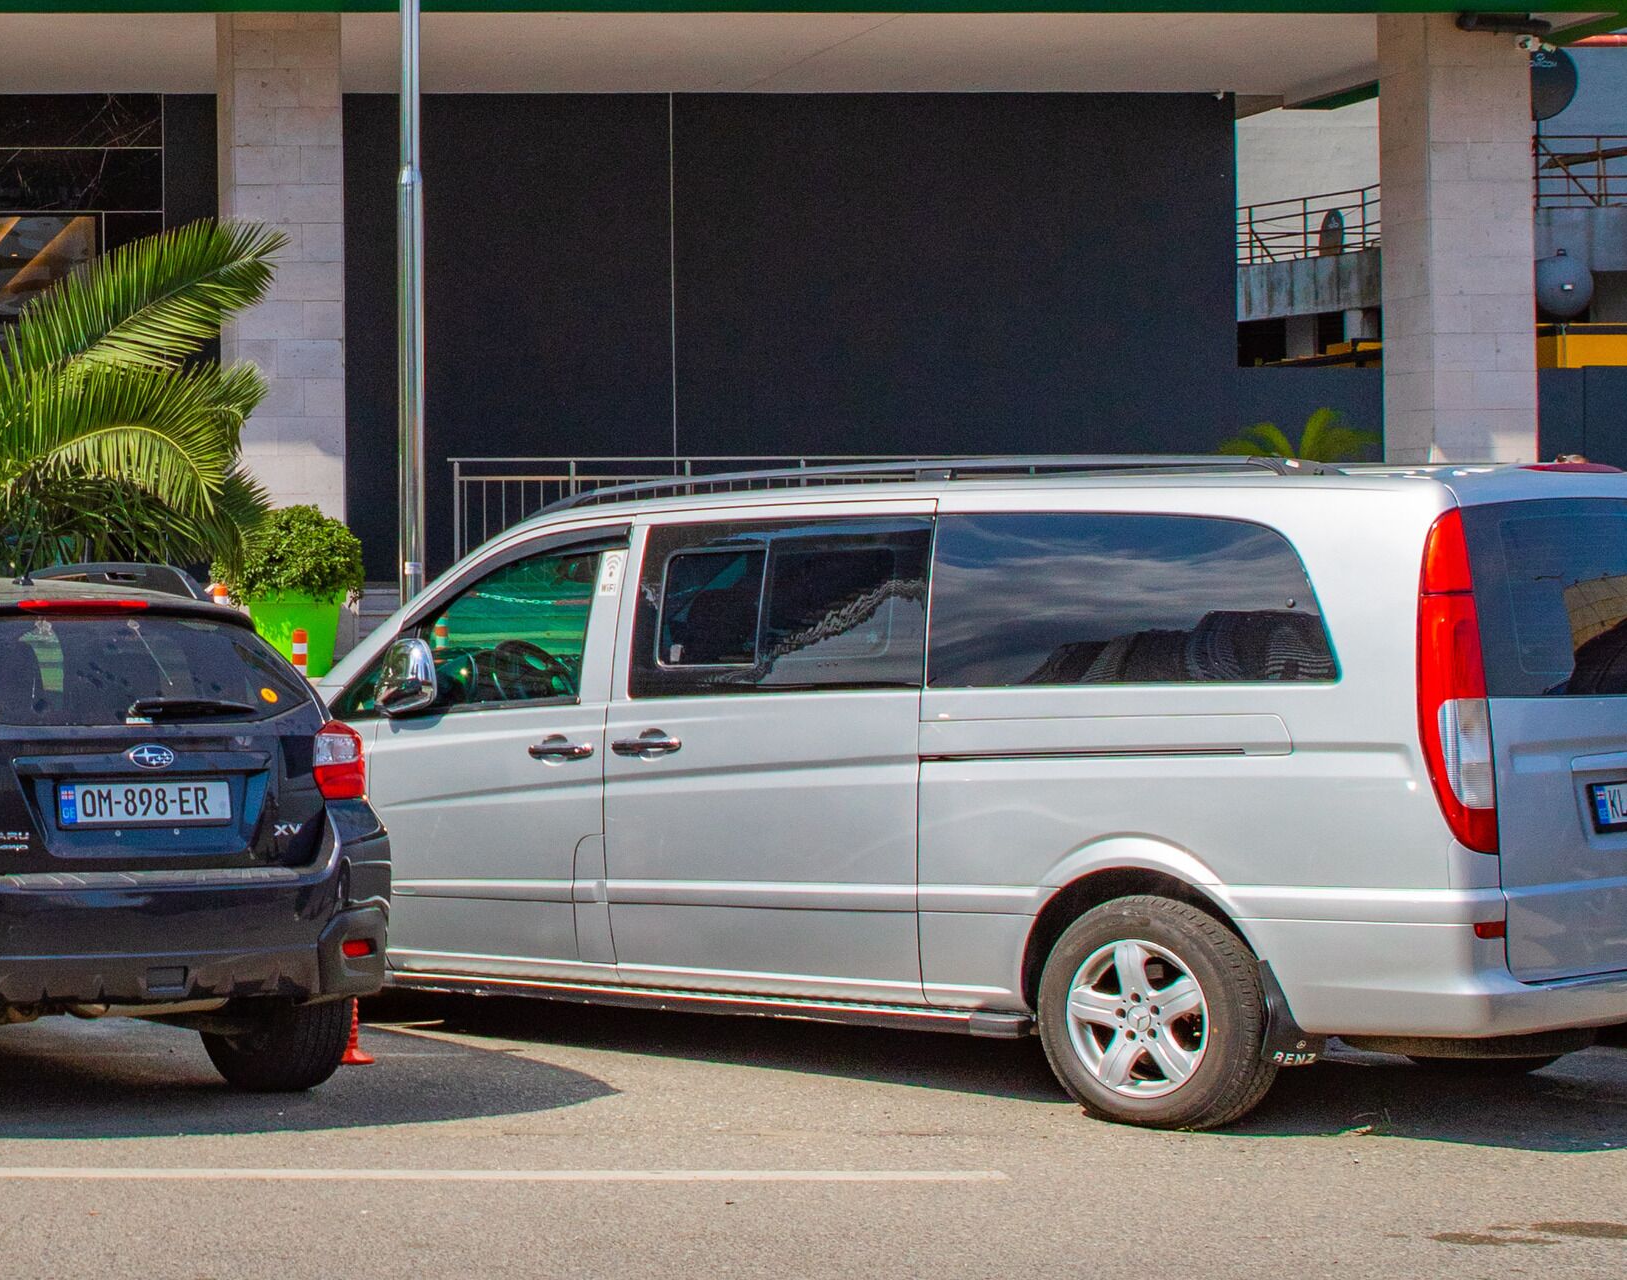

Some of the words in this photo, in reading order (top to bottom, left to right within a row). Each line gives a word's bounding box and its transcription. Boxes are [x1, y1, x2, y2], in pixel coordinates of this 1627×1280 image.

[81, 786, 210, 818] OM-898-ER
[274, 823, 303, 836] XV
[1273, 1050, 1317, 1065] BENZ
